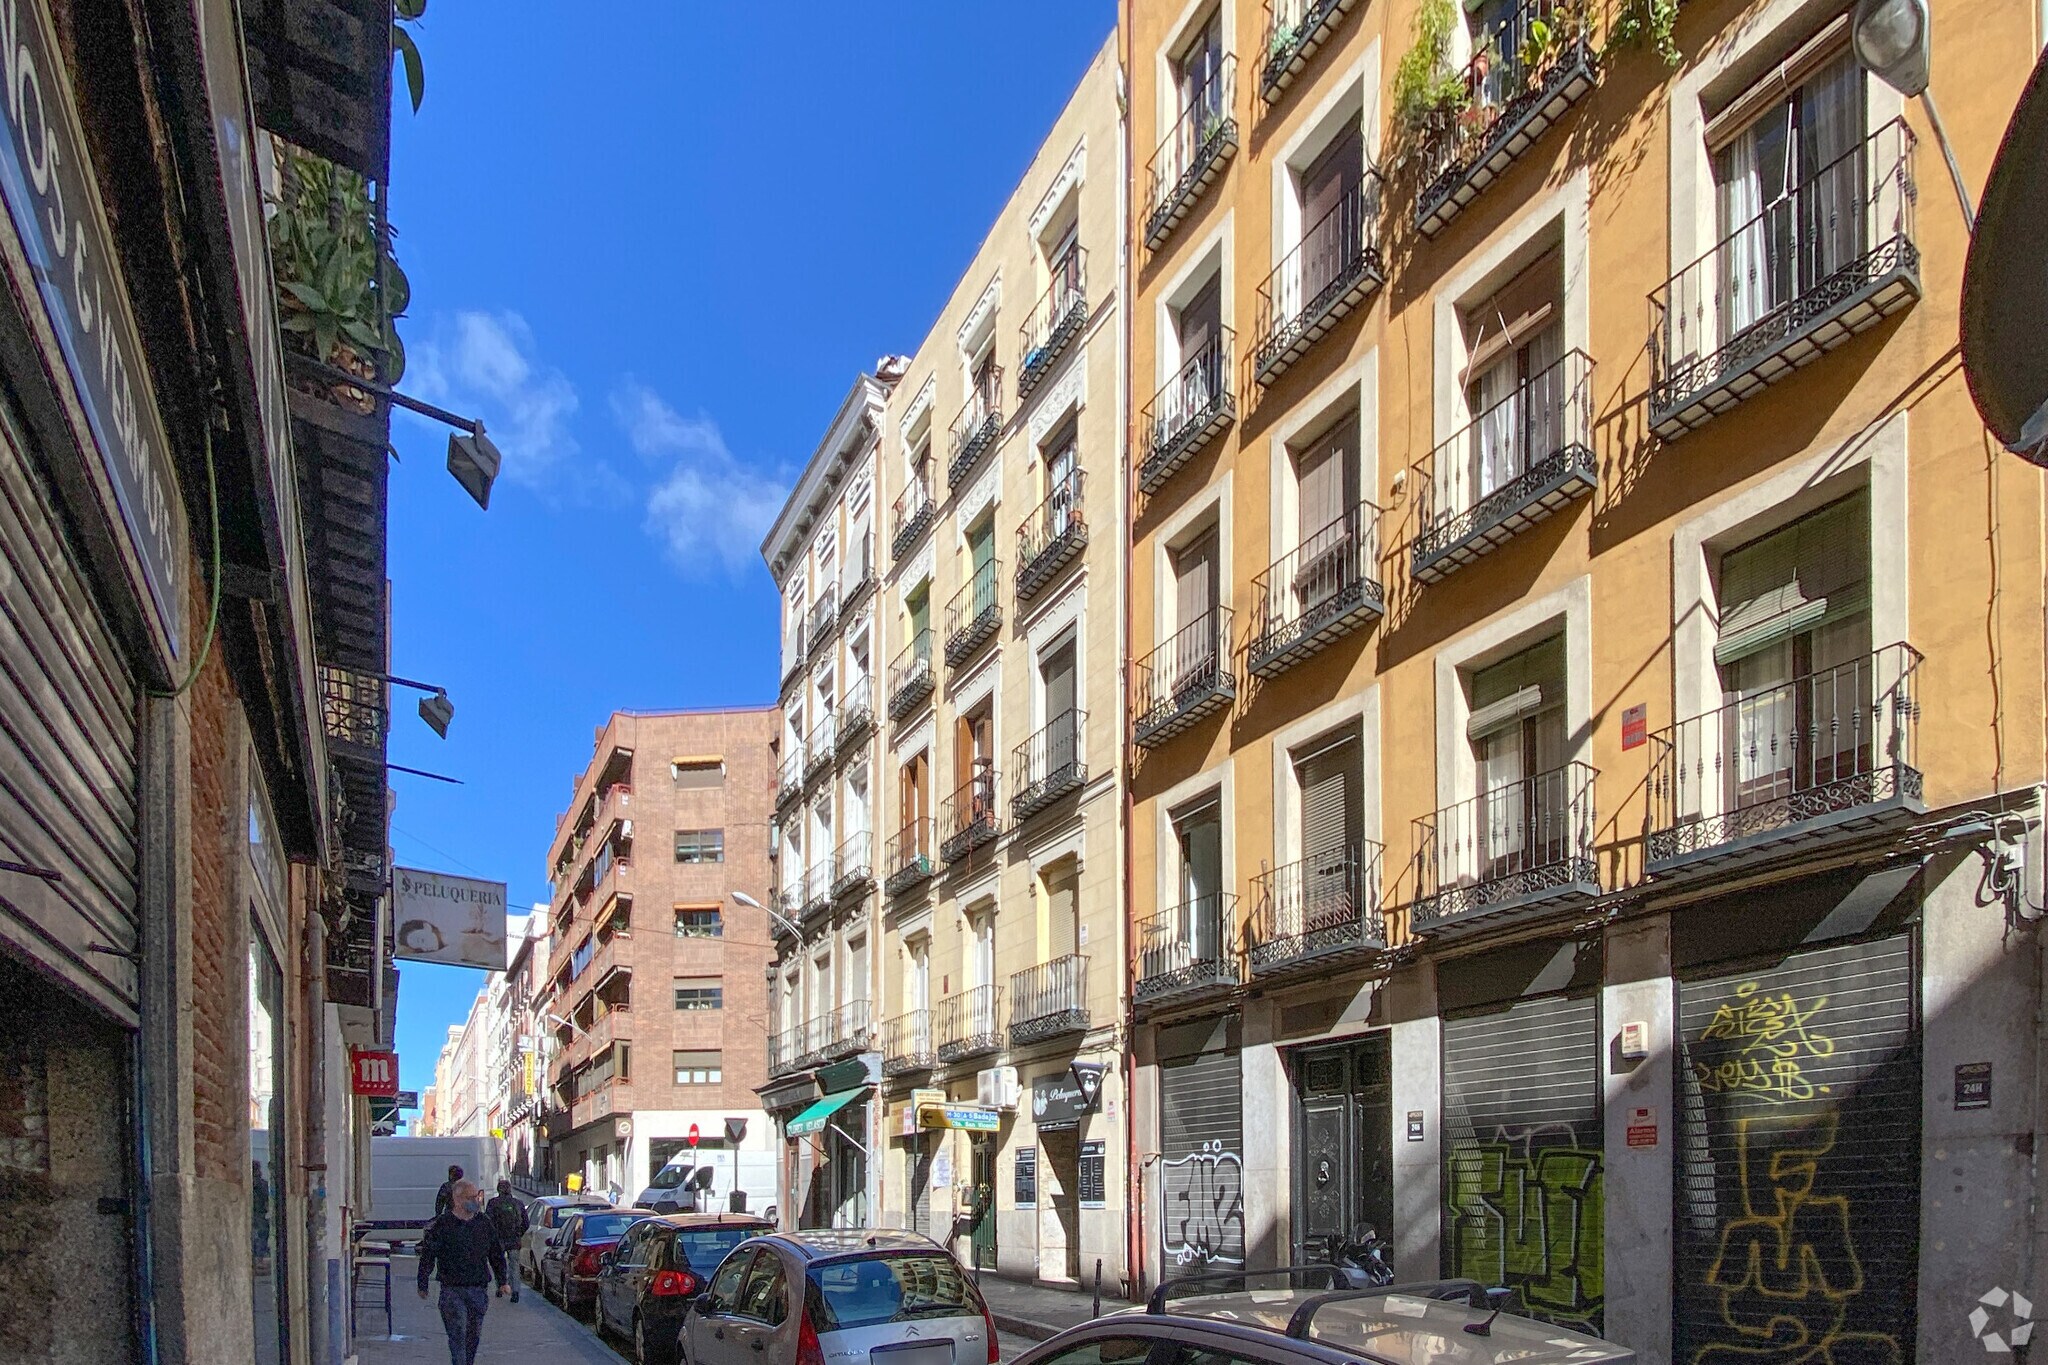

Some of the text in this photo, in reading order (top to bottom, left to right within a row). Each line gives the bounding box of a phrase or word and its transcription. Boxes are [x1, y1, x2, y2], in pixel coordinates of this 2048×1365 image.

[73, 219, 94, 334] &
[95, 272, 173, 586] VERMUTS
[414, 881, 502, 906] PELUQUERIA
[1963, 1083, 1983, 1094] 24H
